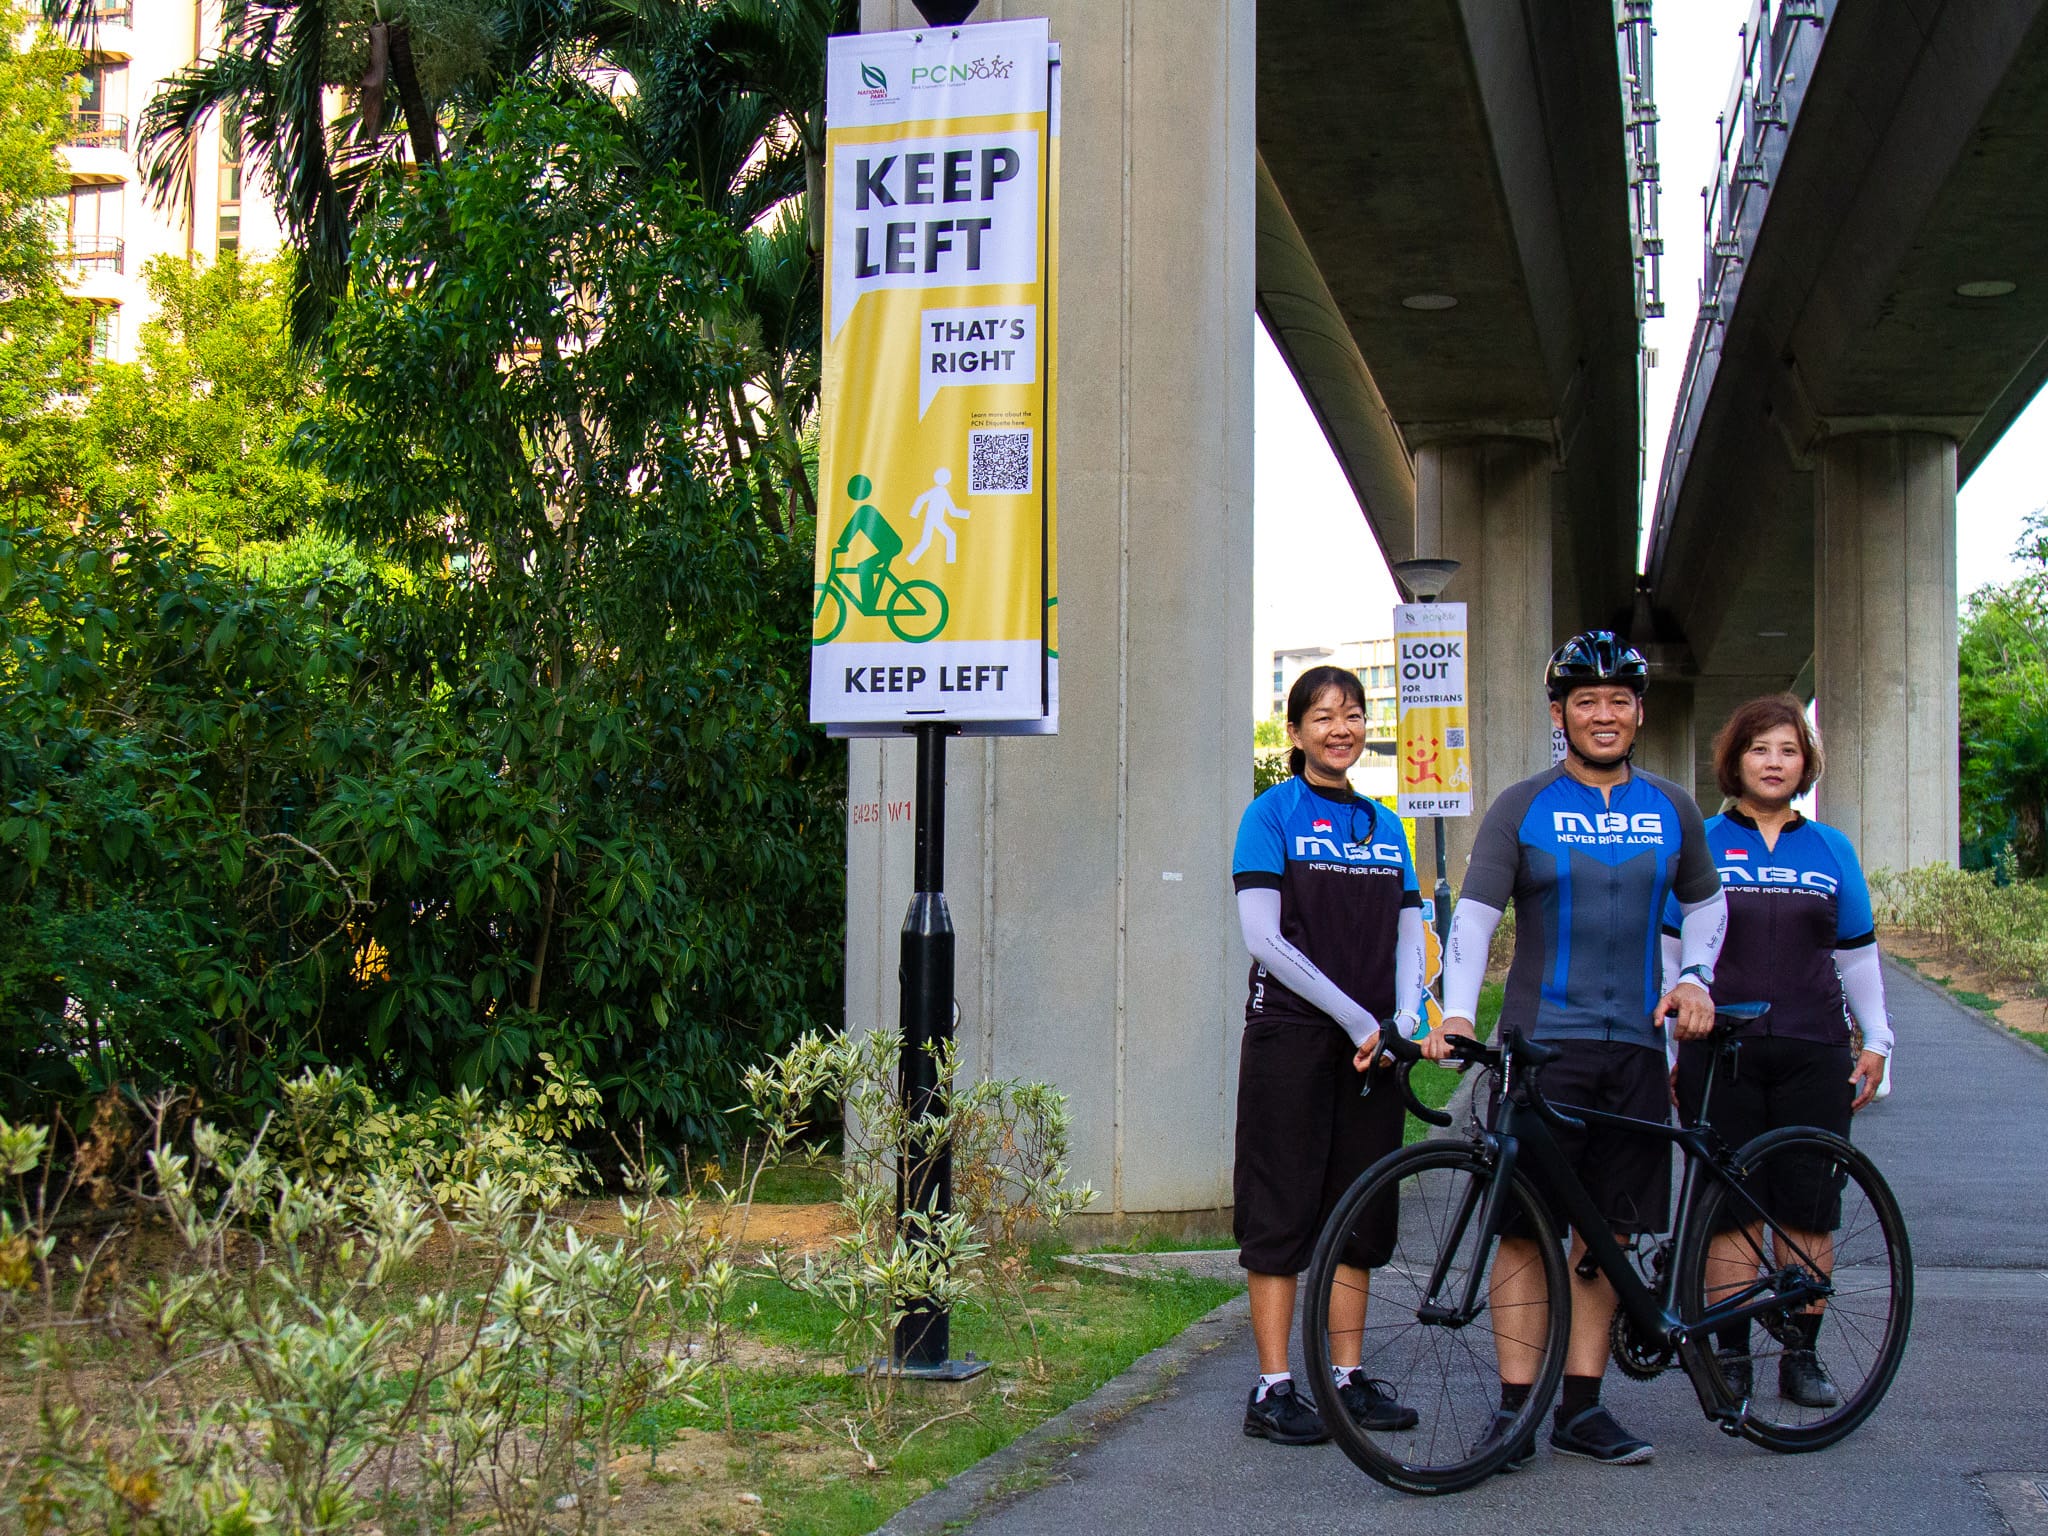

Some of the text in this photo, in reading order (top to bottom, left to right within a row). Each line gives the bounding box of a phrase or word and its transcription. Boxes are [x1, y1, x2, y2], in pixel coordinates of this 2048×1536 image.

[911, 63, 968, 85] PCN
[857, 88, 886, 96] NATIONAL
[855, 147, 1020, 211] KEEP
[855, 217, 992, 279] LEFT
[931, 318, 1025, 342] THAT'S
[931, 350, 1016, 373] RIGHT
[1402, 642, 1461, 660] LOOK
[844, 665, 1009, 693] KEEP LEFT
[1402, 662, 1449, 680] OUT
[1402, 684, 1421, 693] FOR
[1402, 694, 1463, 703] PEDESTRIANS
[853, 803, 879, 824] E425
[1408, 800, 1460, 809] KEEP LEFT
[1553, 811, 1663, 833] MBG
[1557, 833, 1665, 845] NEVER RIDE ALONE
[1295, 836, 1403, 863] MBG
[1309, 862, 1399, 878] NEVER RIDE ALONE
[1762, 886, 1790, 894] RIDE
[1792, 888, 1829, 900] ALONE
